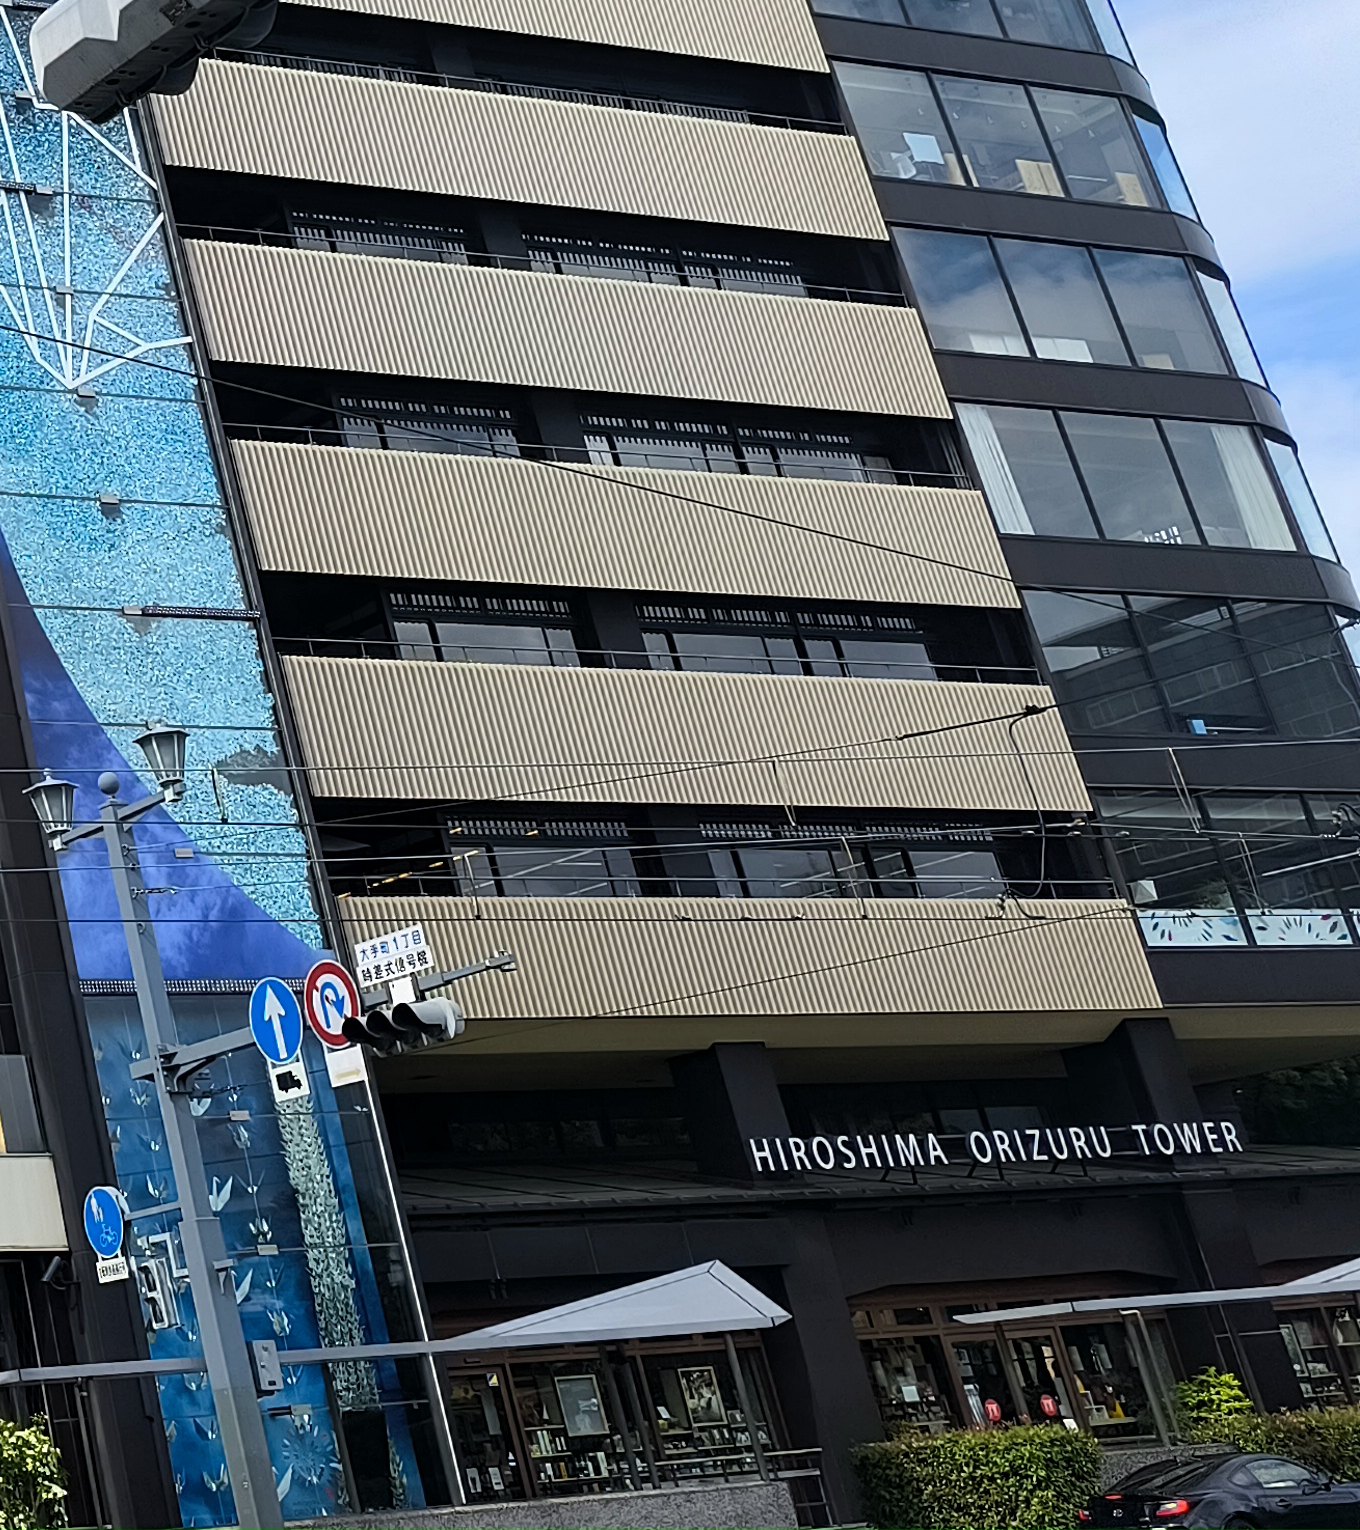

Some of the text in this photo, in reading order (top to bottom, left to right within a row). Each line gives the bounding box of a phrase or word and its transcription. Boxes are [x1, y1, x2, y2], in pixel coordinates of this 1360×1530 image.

[748, 1120, 1244, 1172] HIROSHIMA ORIZURU TOWER
